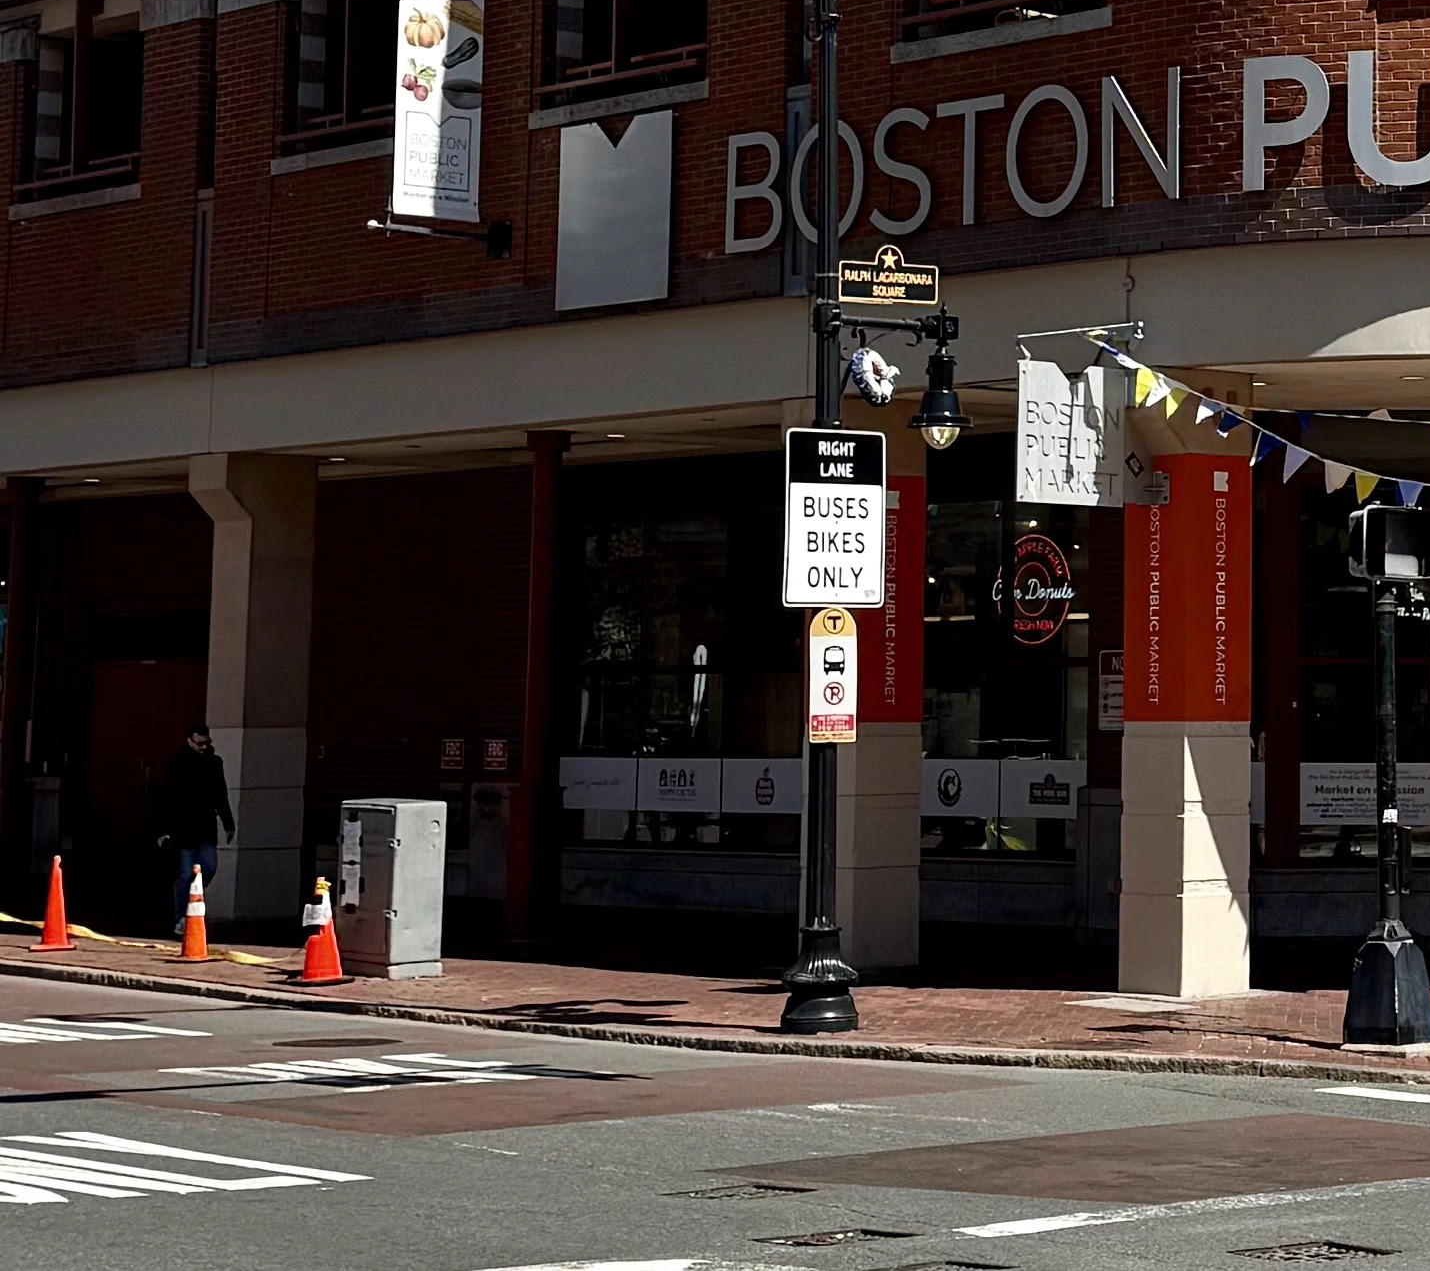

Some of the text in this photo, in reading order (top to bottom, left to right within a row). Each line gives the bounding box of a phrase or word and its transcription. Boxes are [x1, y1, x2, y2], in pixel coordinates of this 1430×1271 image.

[410, 133, 468, 151] BOSTON
[410, 150, 459, 167] PUBLIC
[724, 65, 1183, 255] BOSTON
[410, 168, 466, 185] MARKET
[872, 285, 906, 298] SQUARE
[1026, 400, 1120, 431] BOSTON
[818, 440, 857, 457] RIGHT
[1026, 434, 1106, 462] PUBLIC
[820, 462, 854, 478] LANE
[1025, 467, 1119, 497] MARKET
[803, 496, 869, 519] BUSES
[807, 531, 866, 554] BIKES
[807, 566, 863, 588] ONLY
[1025, 578, 1076, 600] Donuts
[884, 514, 898, 706] BOSTON PUBLIC MARKET
[1148, 504, 1161, 705] OSTON PUBLIC MARKET
[1215, 498, 1226, 705] BOSTON PUBLIC MARKET
[1315, 784, 1353, 795] Market
